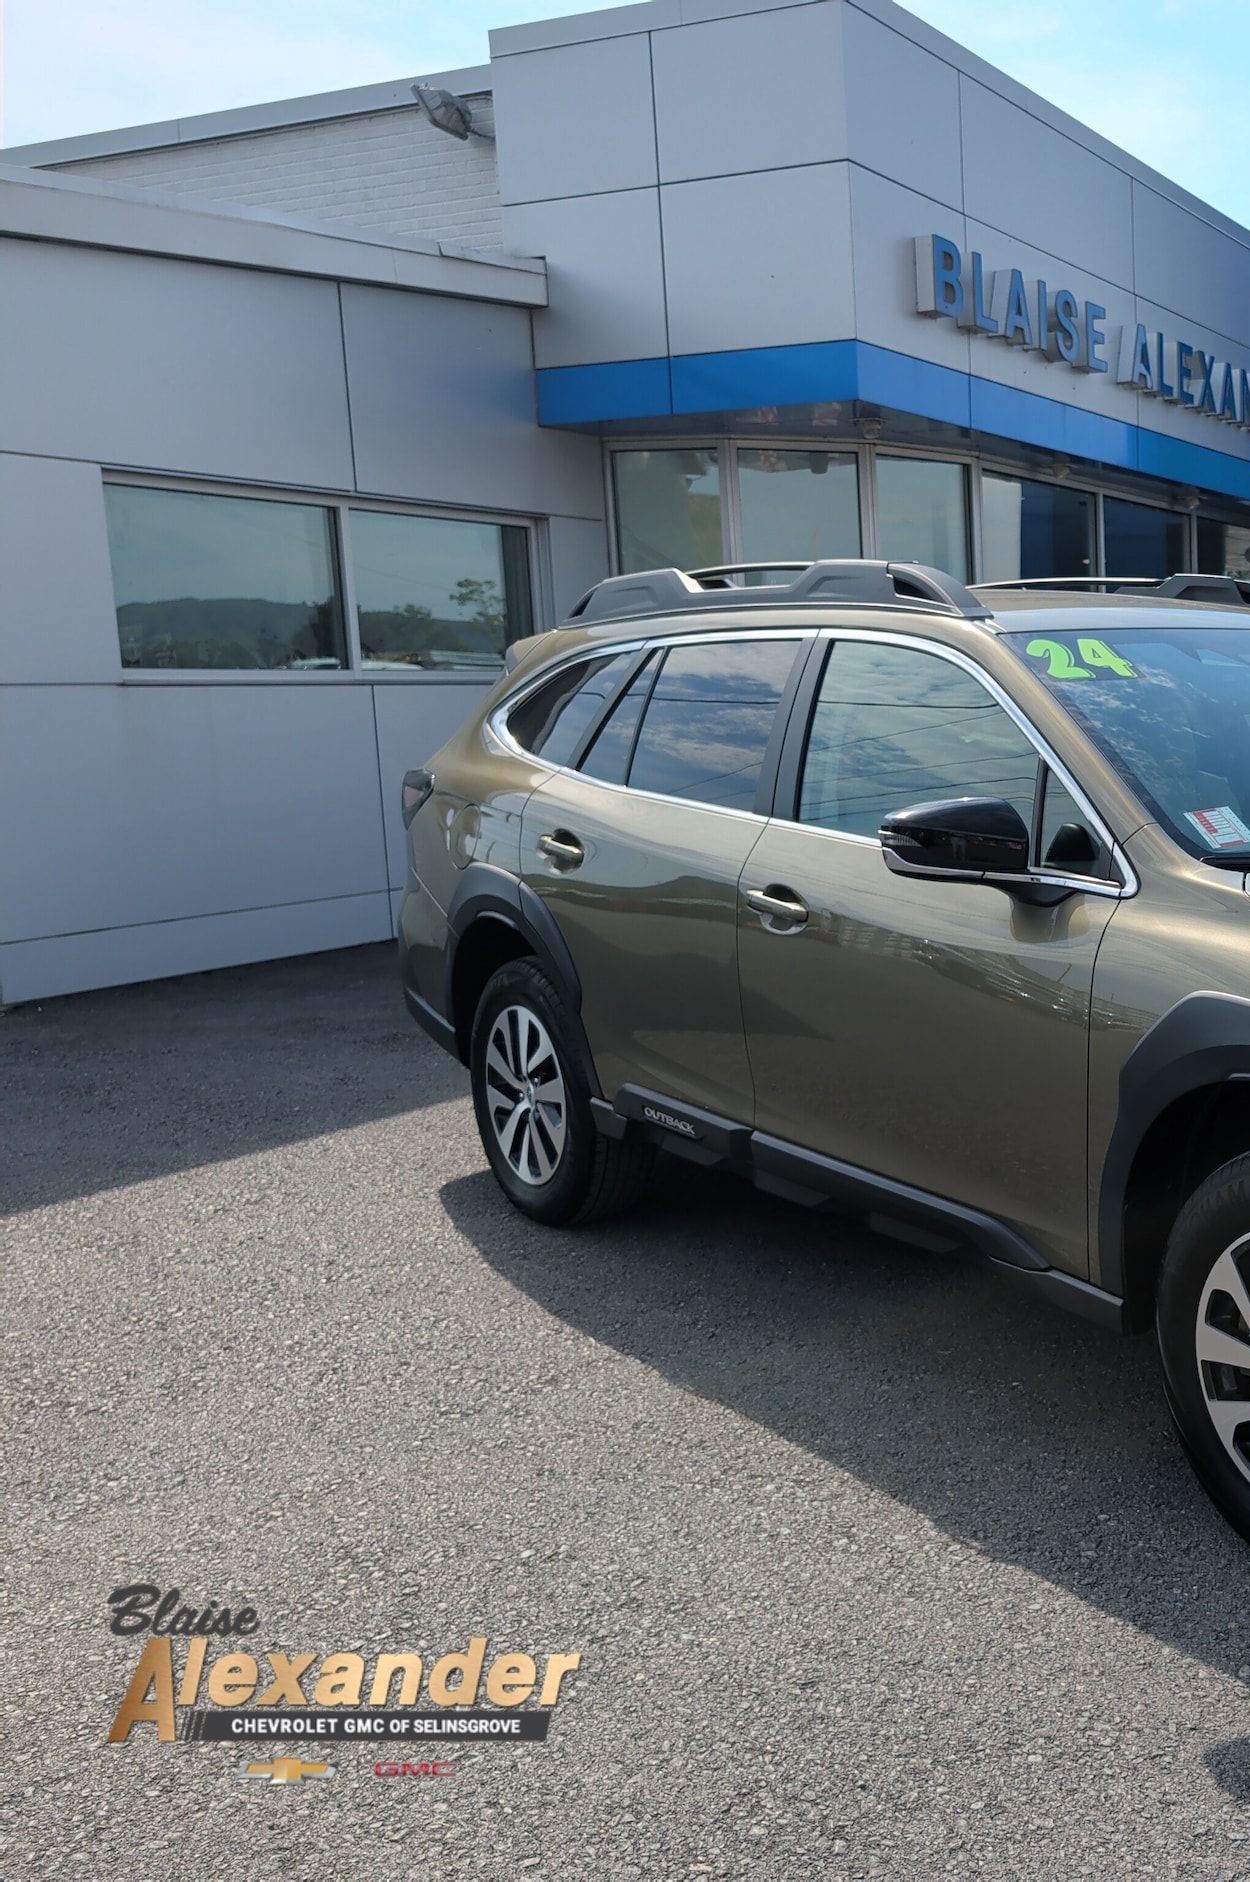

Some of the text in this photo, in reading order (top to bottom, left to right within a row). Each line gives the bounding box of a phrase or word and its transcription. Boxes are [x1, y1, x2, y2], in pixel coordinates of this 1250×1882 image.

[926, 233, 1108, 374] BLAISE
[1026, 638, 1139, 680] 24
[644, 1106, 696, 1135] OUTBACK
